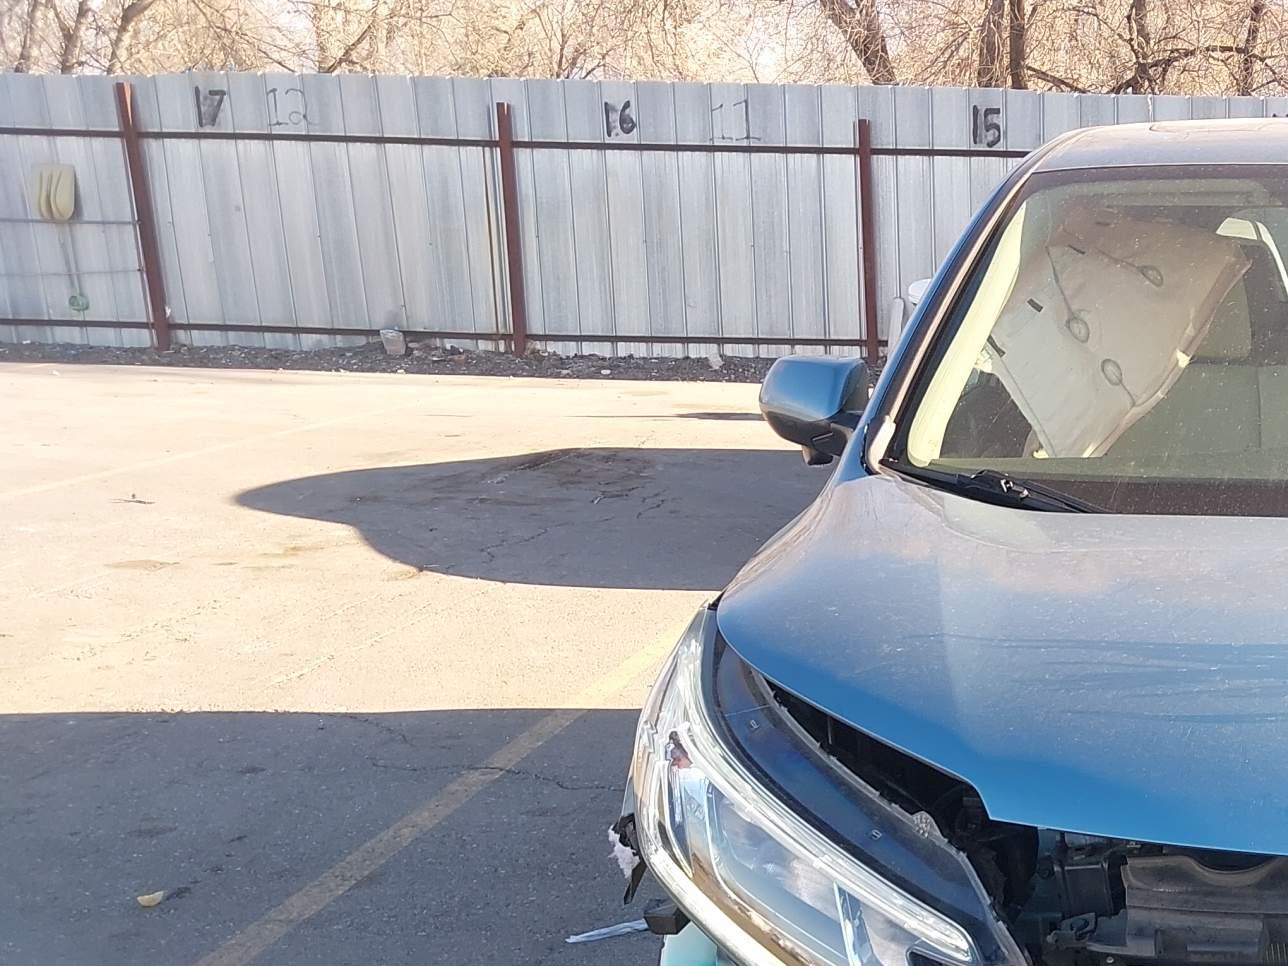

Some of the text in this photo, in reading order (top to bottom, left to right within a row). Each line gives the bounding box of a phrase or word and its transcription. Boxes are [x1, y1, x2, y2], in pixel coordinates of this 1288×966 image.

[195, 86, 227, 128] 17
[604, 100, 637, 138] 16
[972, 105, 1001, 148] 15
